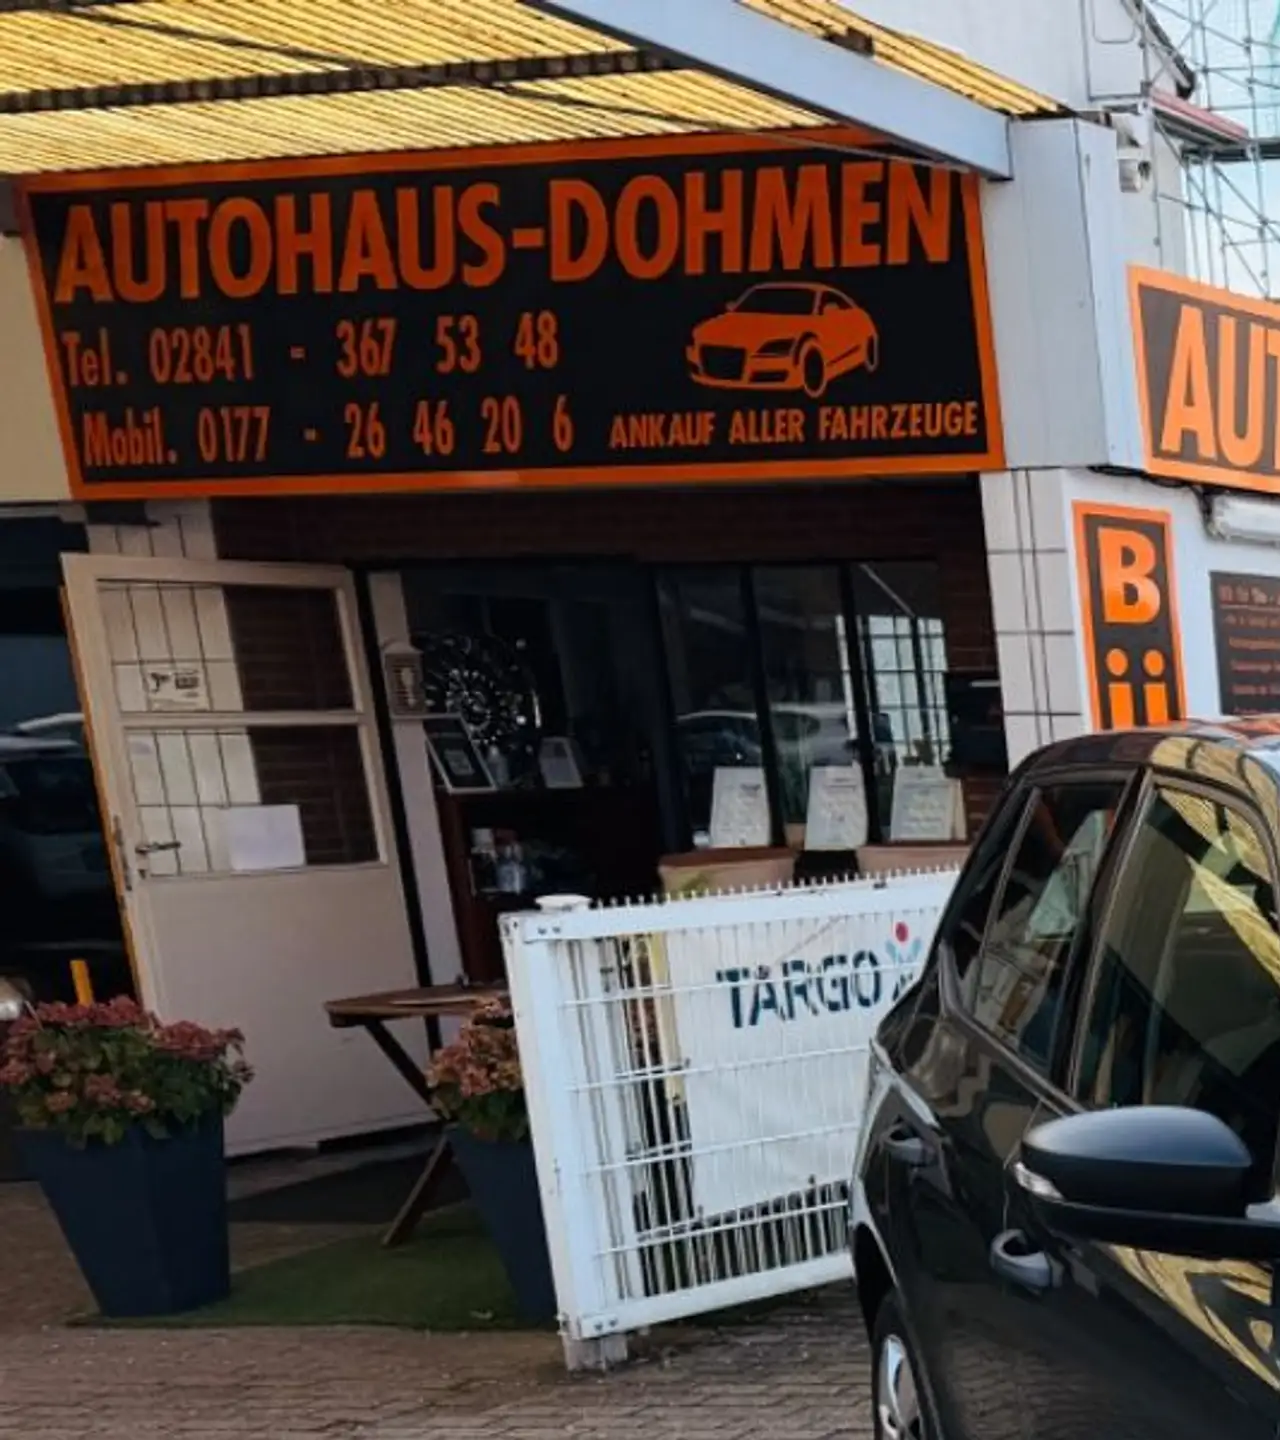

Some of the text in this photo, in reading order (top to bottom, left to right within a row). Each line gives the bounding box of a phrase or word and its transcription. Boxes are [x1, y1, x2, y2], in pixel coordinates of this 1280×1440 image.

[54, 161, 951, 302] AUTOHAUS-DOHMEN
[61, 327, 128, 386] Tel.
[148, 324, 254, 384] 02841
[336, 318, 397, 378] 367
[436, 314, 482, 373] 53
[514, 310, 559, 370] 48
[82, 405, 178, 467] Mobil.
[197, 405, 270, 463] 0177
[344, 402, 385, 458] 26
[412, 400, 454, 456] 46
[481, 395, 522, 453] 20
[553, 395, 574, 452] 6
[609, 402, 979, 448] ANKAUF ALLER FAHRZEUGE
